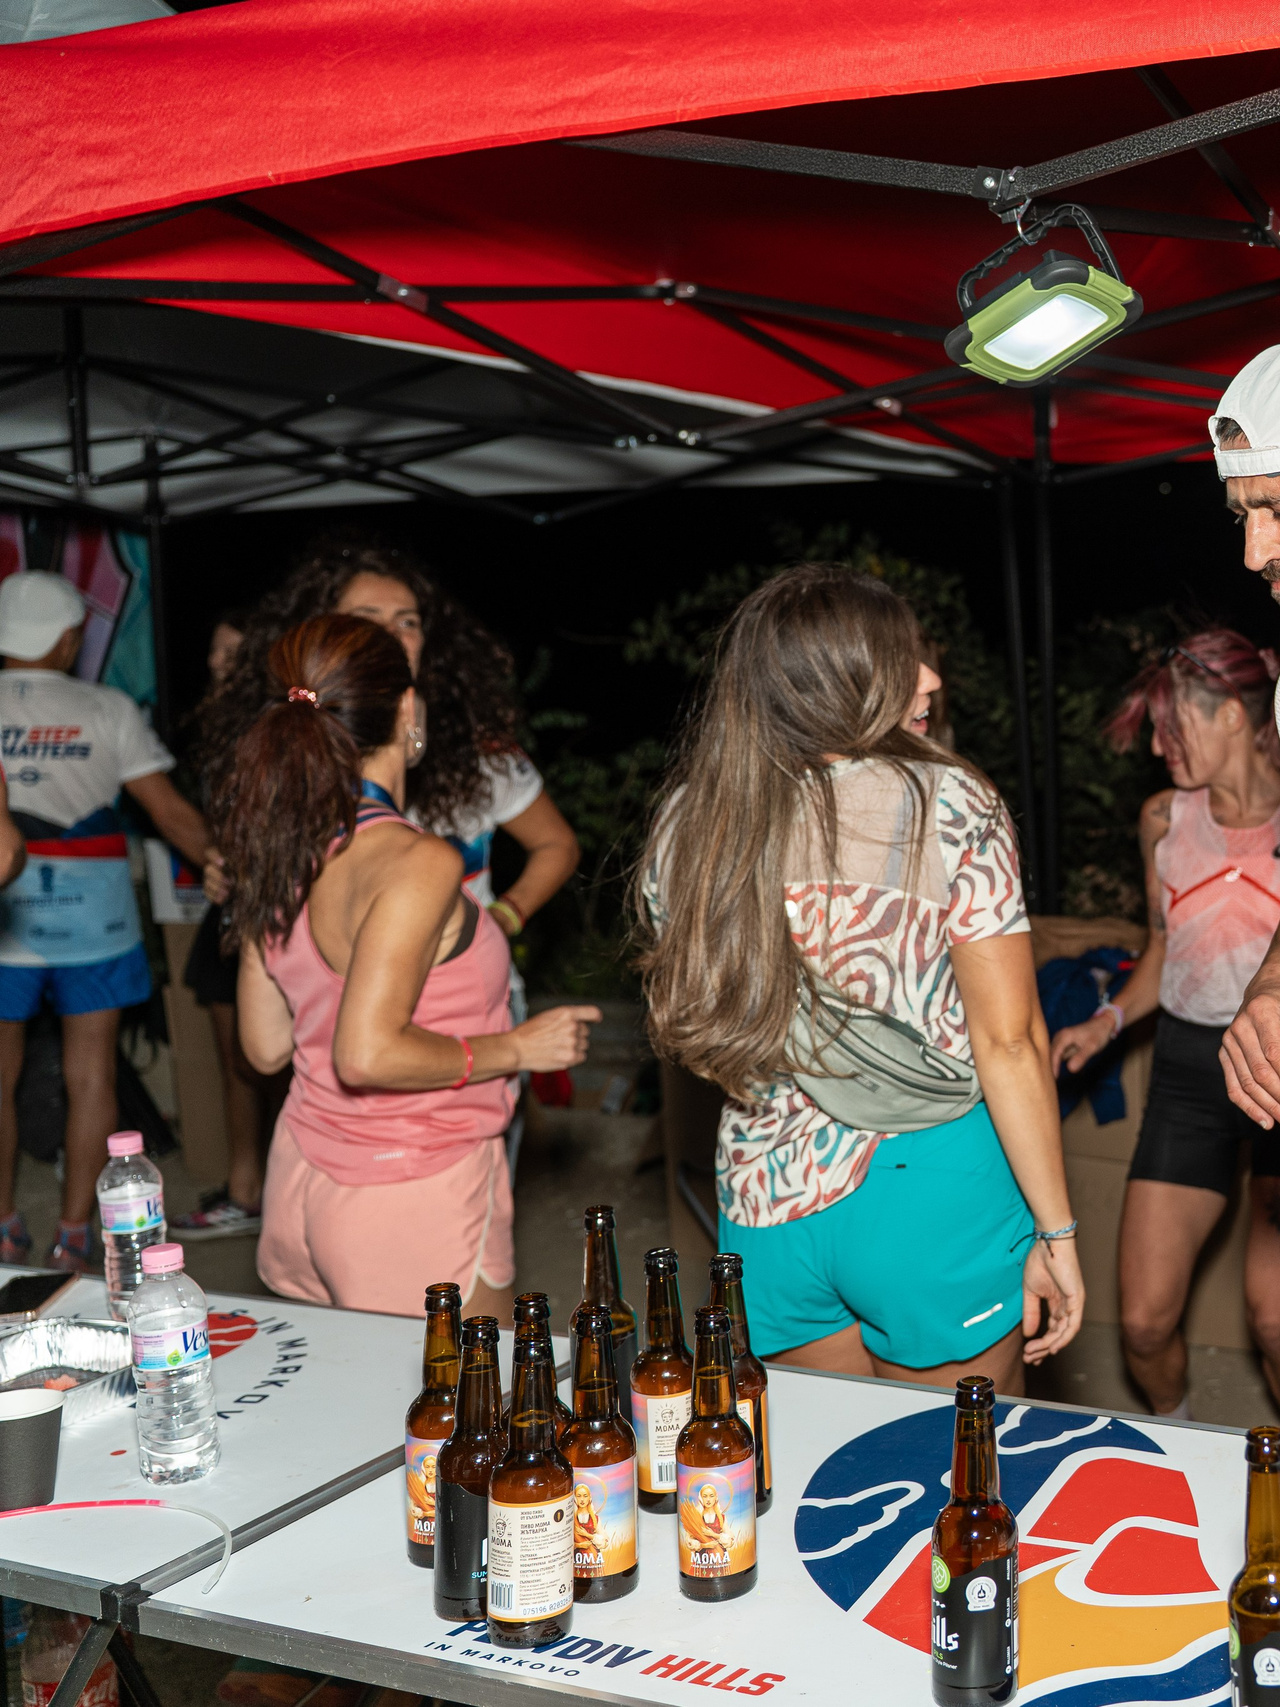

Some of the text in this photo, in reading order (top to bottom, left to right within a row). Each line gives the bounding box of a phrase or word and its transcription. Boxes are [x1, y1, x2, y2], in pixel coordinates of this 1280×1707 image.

[29, 726, 82, 743] STEP
[146, 1199, 161, 1217] Ve
[182, 1326, 209, 1354] Ves
[216, 1337, 308, 1420] MARKOV
[574, 1551, 605, 1564] OMA
[932, 1615, 960, 1652] ills
[424, 1641, 581, 1677] IN MARKOVO
[446, 1620, 786, 1697] PVDIV HILLS
